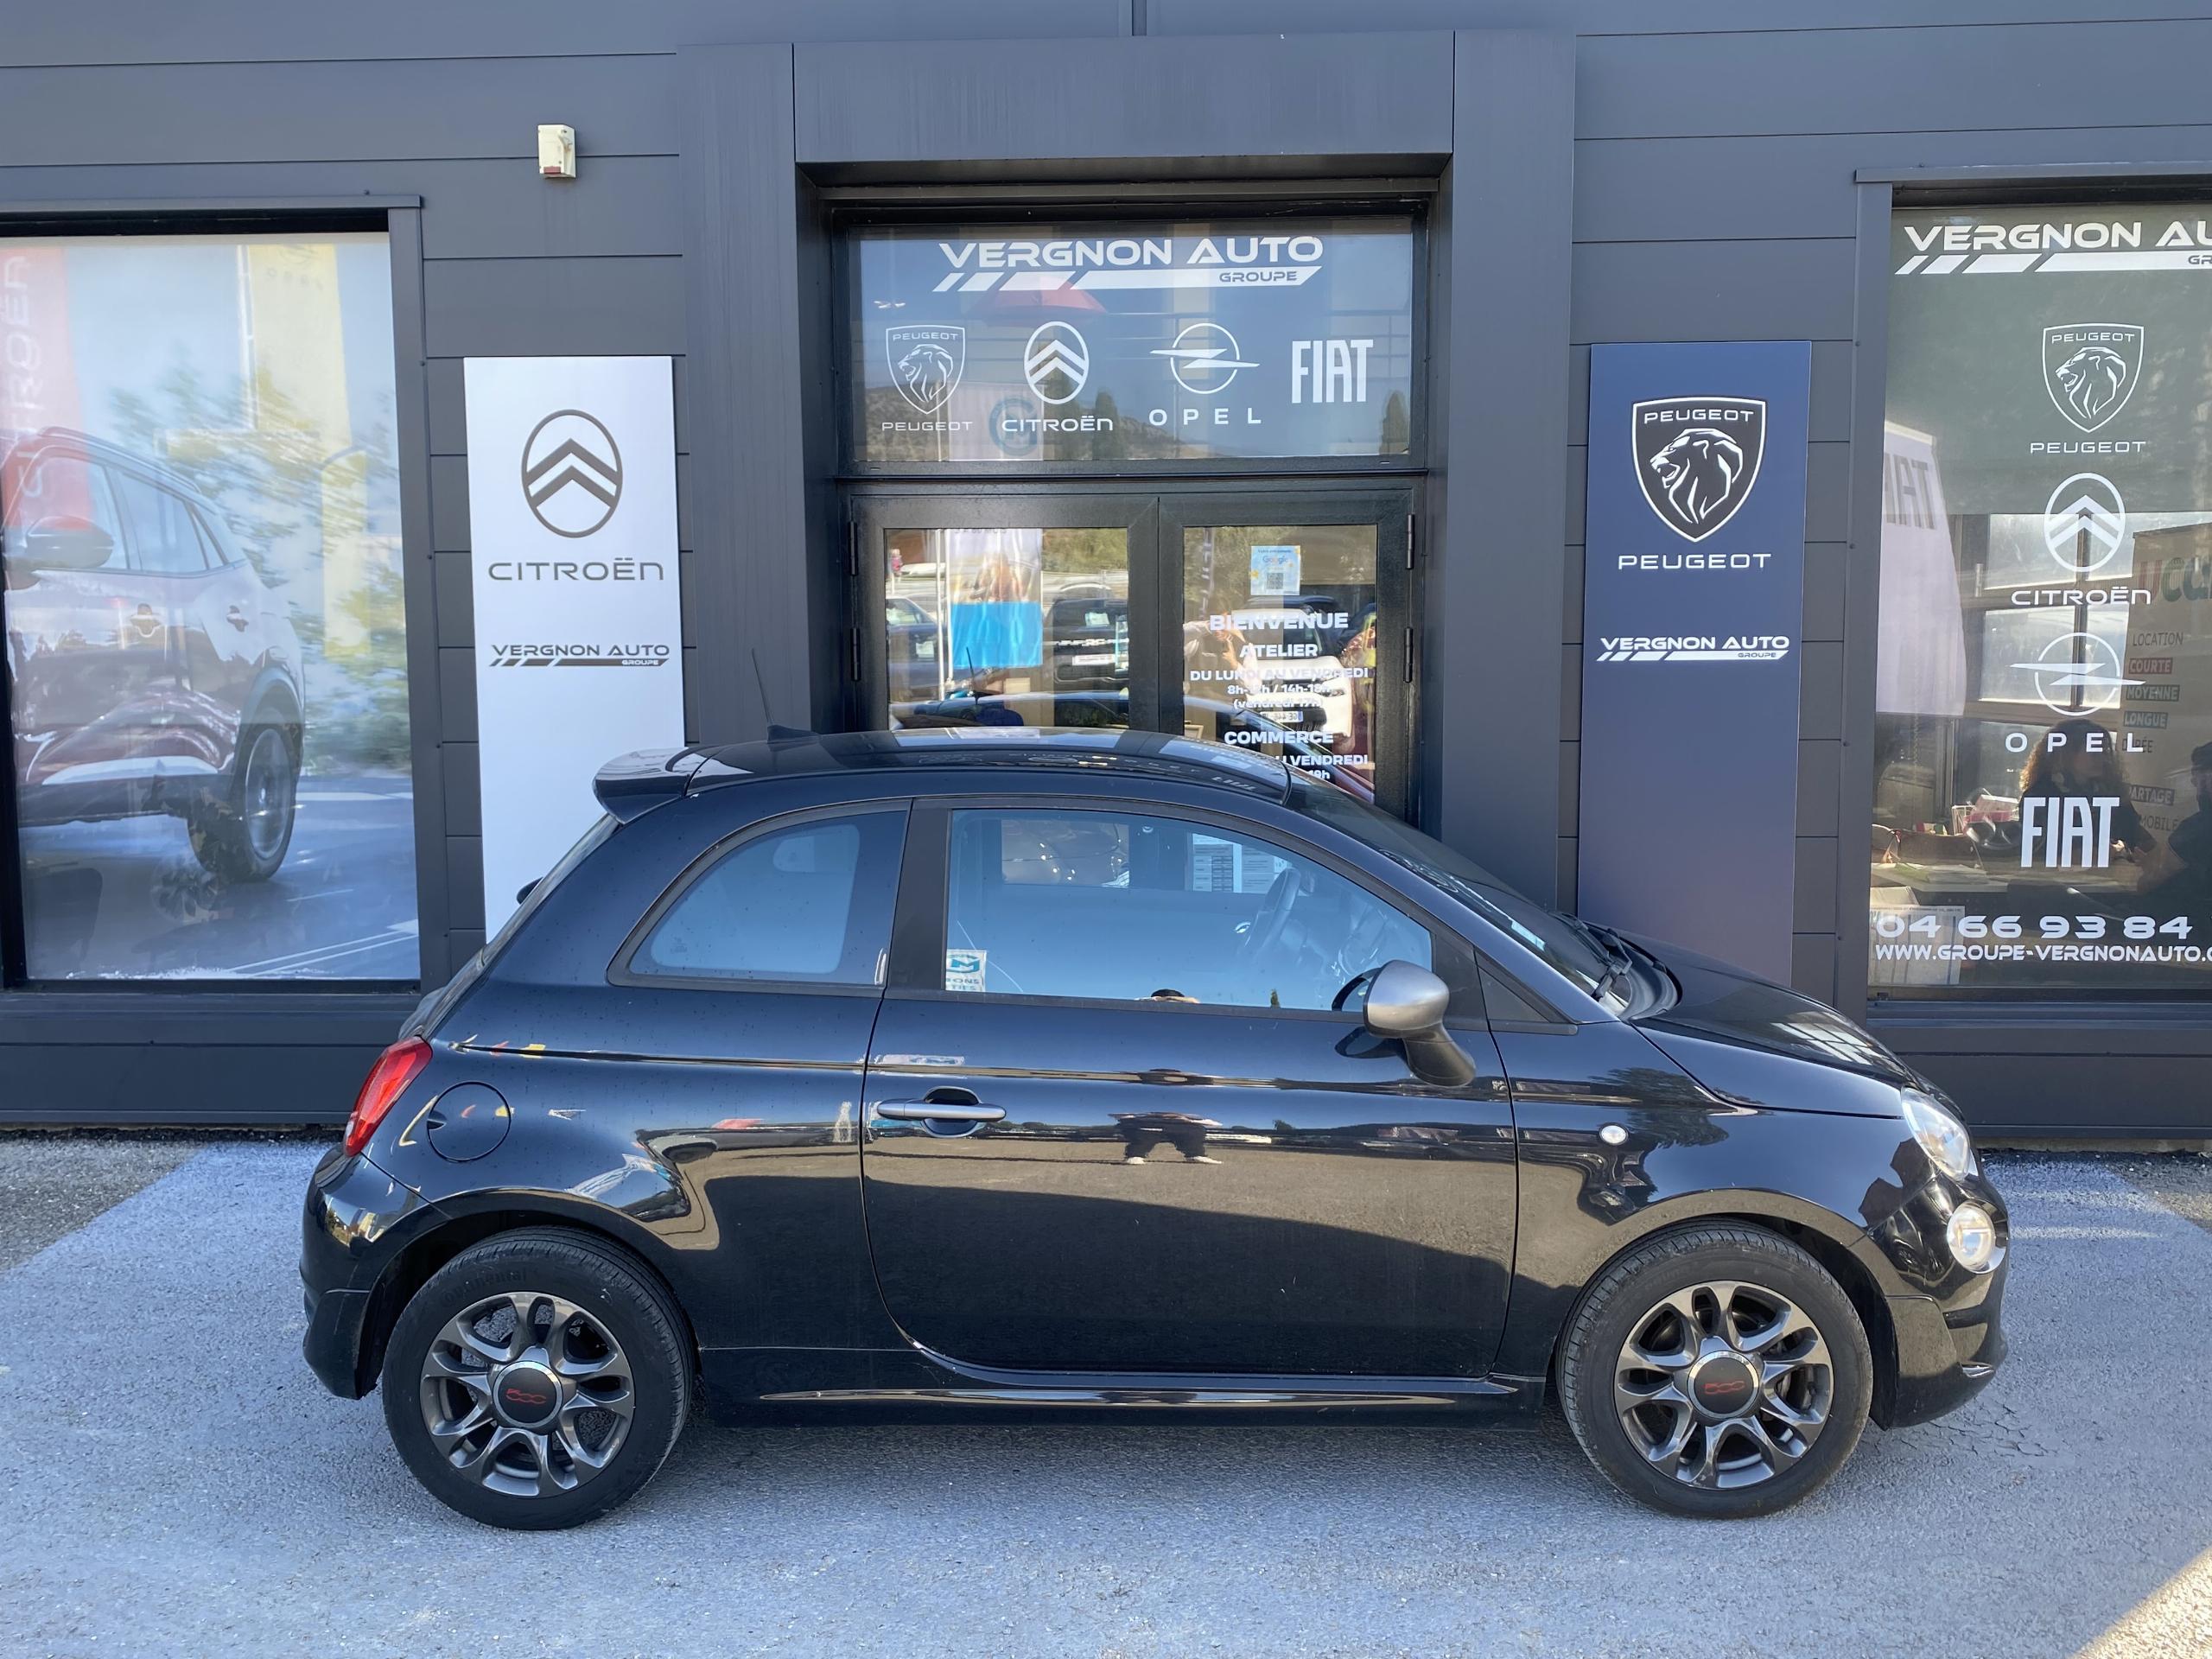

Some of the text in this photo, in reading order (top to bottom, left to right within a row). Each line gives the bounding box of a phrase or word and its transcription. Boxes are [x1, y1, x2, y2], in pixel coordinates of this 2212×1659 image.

[1904, 221, 2141, 251] VERGNON
[938, 236, 1324, 268] VERGNON AUTO
[1219, 271, 1298, 283] GROUPE
[892, 331, 958, 342] PEUGEOT
[2051, 331, 2135, 344] PEUGEOT
[1292, 339, 1373, 404] FIAT
[1001, 415, 1113, 432] CITROËN
[1149, 408, 1262, 427] OPEL
[1643, 408, 1754, 424] PEUGEOT
[881, 421, 973, 432] PEUGEOT
[2031, 442, 2146, 454] PEUGEOT
[488, 557, 664, 581] CITROËN
[1618, 553, 1771, 569] PEUGEOT
[2011, 586, 2152, 606] CITROËN
[1210, 613, 1349, 631] BIENVENUE
[1600, 635, 1789, 651] VERGNON AUTO
[2133, 632, 2184, 646] LOCATION
[491, 645, 670, 657] VERGNON AUTO
[1239, 644, 1319, 658] ATELIER
[2129, 659, 2172, 673] COURTE
[1190, 671, 1211, 682] DU
[2126, 684, 2179, 701] MOYENNE
[2124, 712, 2167, 728] LONGUE
[1224, 731, 1333, 744] COMMERCE
[2005, 732, 2144, 753] OPEL
[2122, 737, 2154, 753] DRÉE
[1290, 754, 1368, 766] VENDREDI
[2021, 797, 2120, 868] FIAT
[1876, 915, 2193, 939] 04 66 93 84
